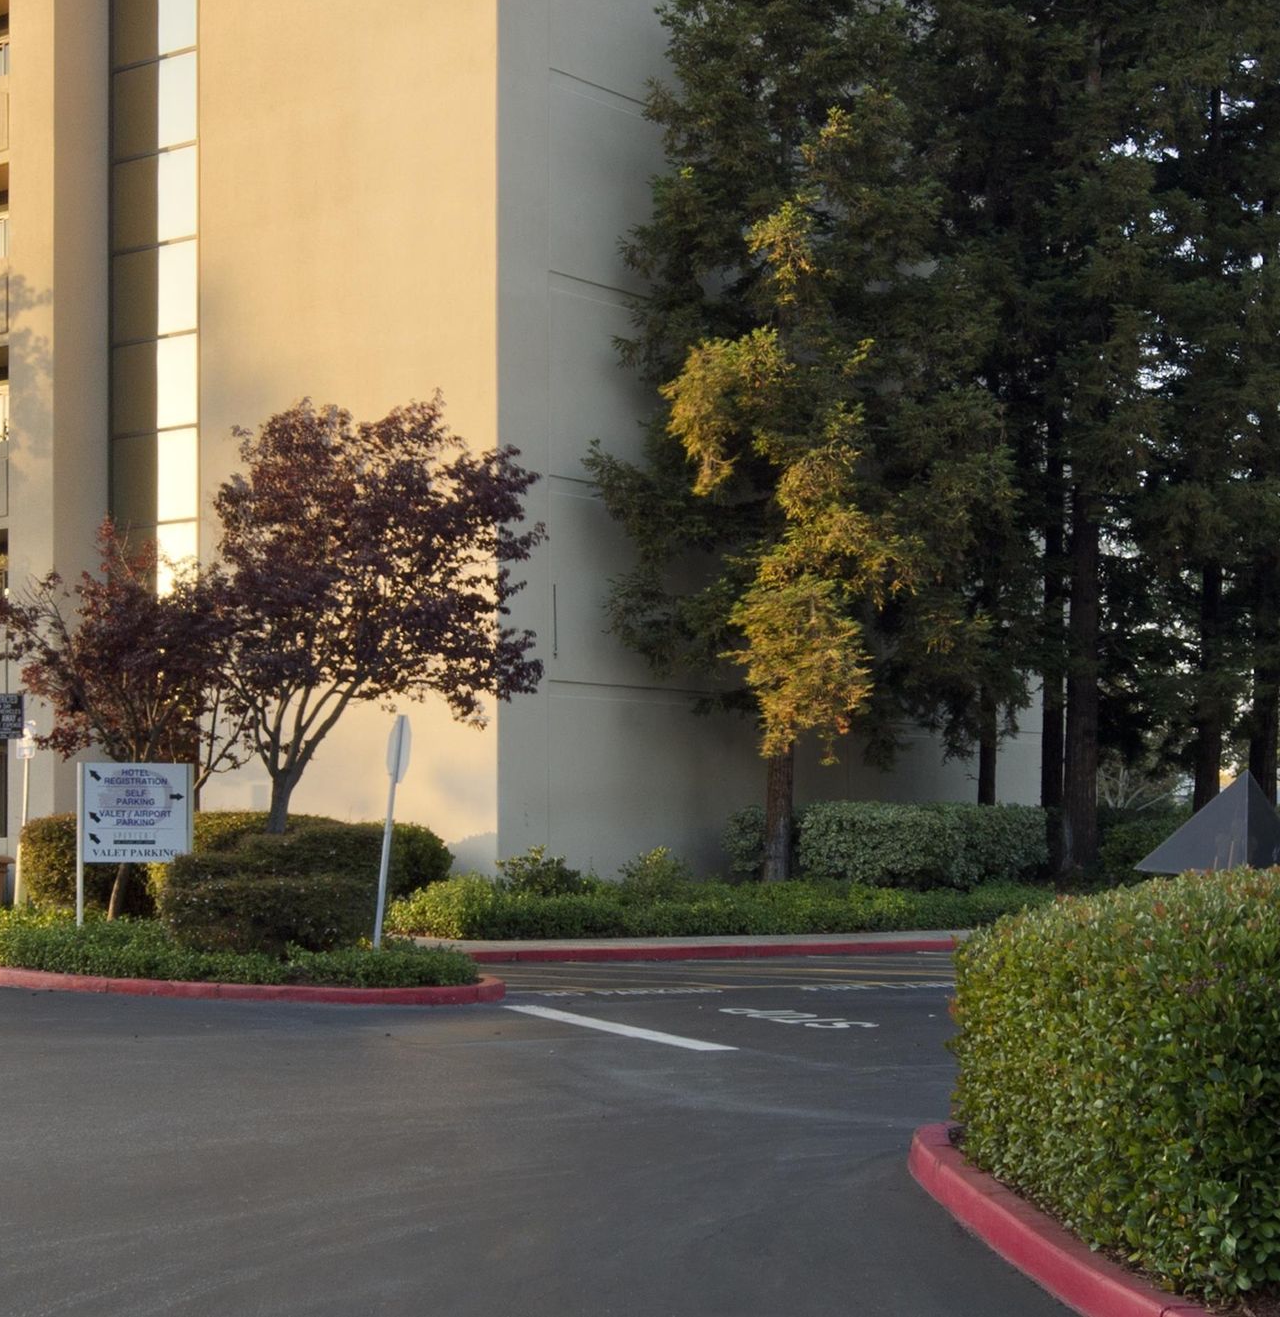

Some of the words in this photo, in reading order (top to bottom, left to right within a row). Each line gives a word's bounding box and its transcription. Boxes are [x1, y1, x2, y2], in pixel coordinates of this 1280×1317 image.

[125, 789, 147, 797] SELF
[116, 798, 155, 806] PARKING
[99, 810, 127, 818] VALET
[134, 810, 172, 818] AIRPORT
[92, 849, 127, 857] VALET
